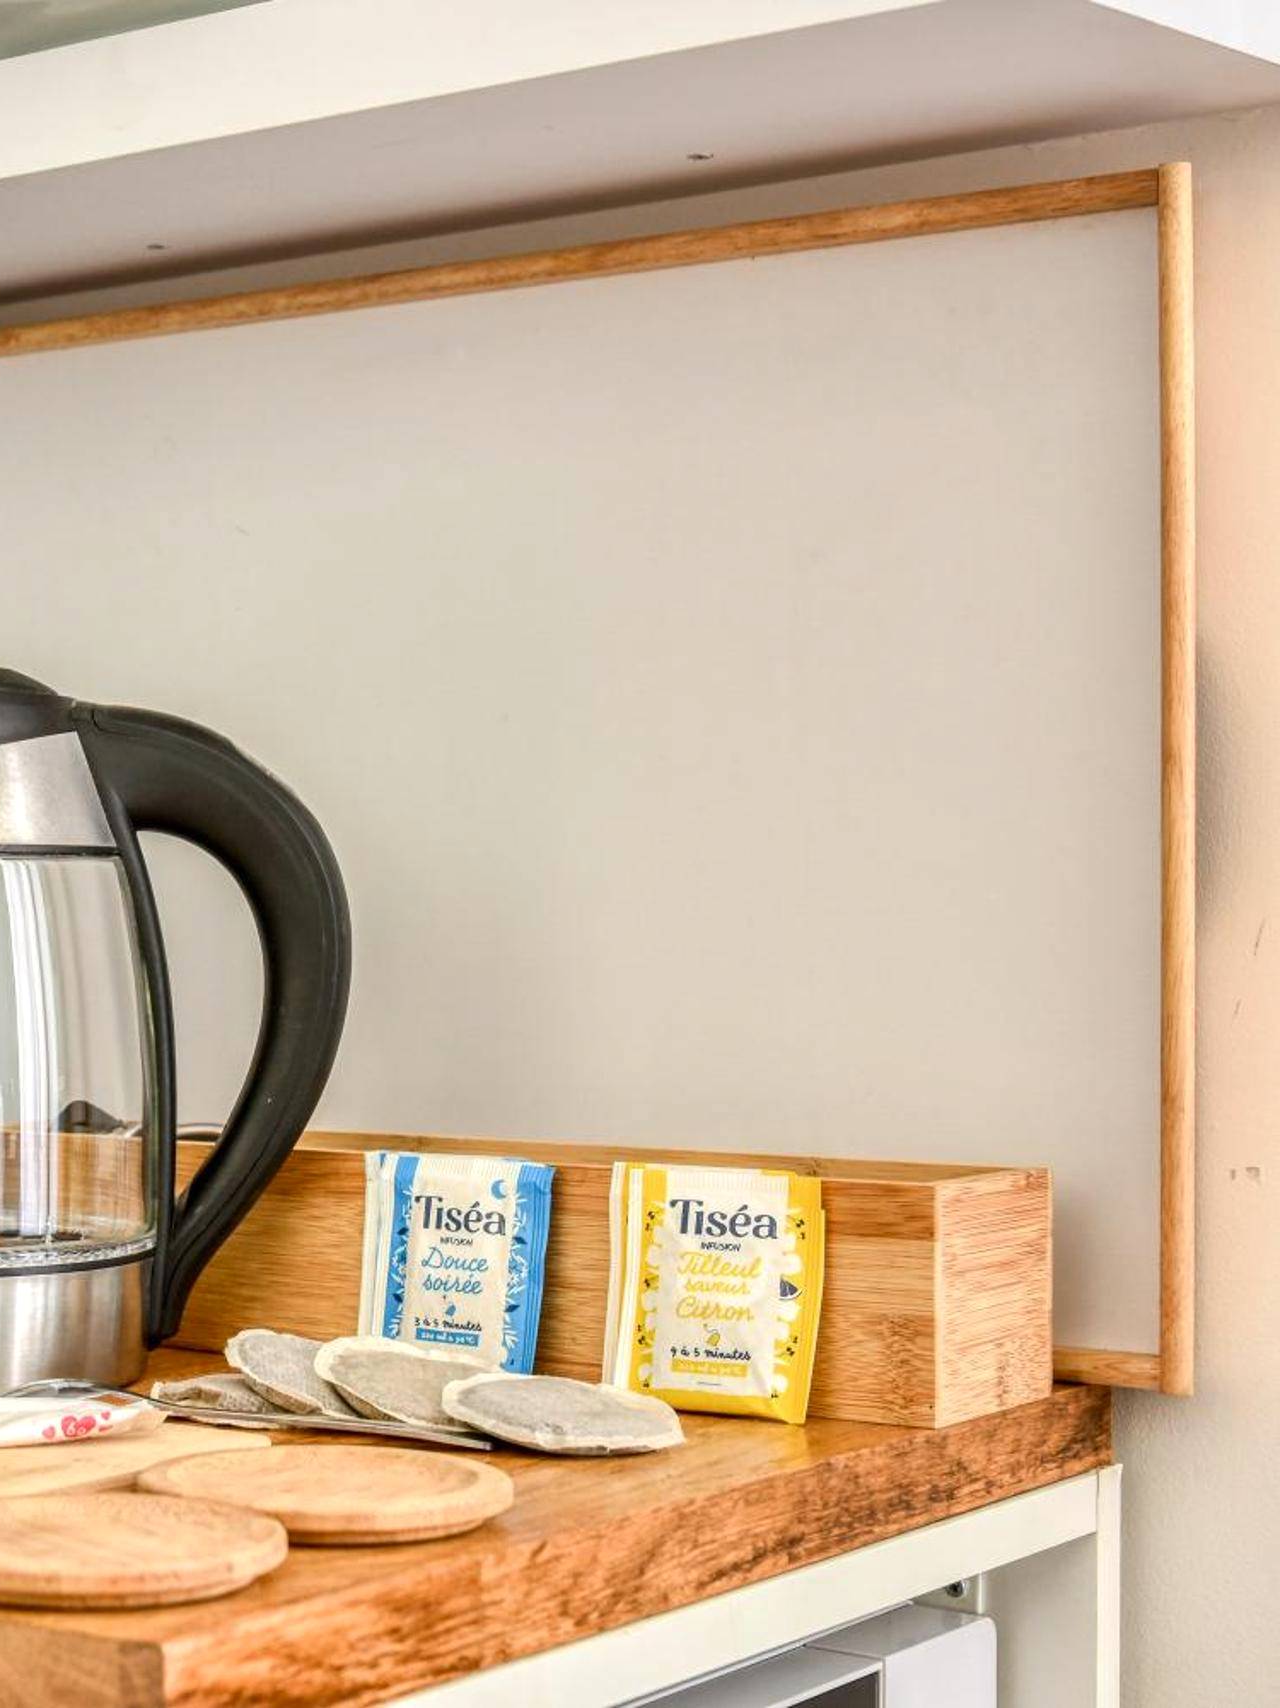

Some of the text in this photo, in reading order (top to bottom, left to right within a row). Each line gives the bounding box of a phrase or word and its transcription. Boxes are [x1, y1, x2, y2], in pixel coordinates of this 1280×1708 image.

[414, 1195, 507, 1236] Tiséa
[669, 1198, 779, 1240] Tiséa
[700, 1241, 742, 1252] INFUSION
[420, 1246, 489, 1272] Douce
[677, 1251, 763, 1278] Tilleul
[422, 1273, 483, 1295] soirée
[684, 1279, 751, 1295] saveur
[675, 1296, 755, 1321] Citron
[414, 1316, 421, 1327] 3
[441, 1318, 483, 1332] minutes
[694, 1346, 701, 1358] 5
[703, 1347, 752, 1361] minutes
